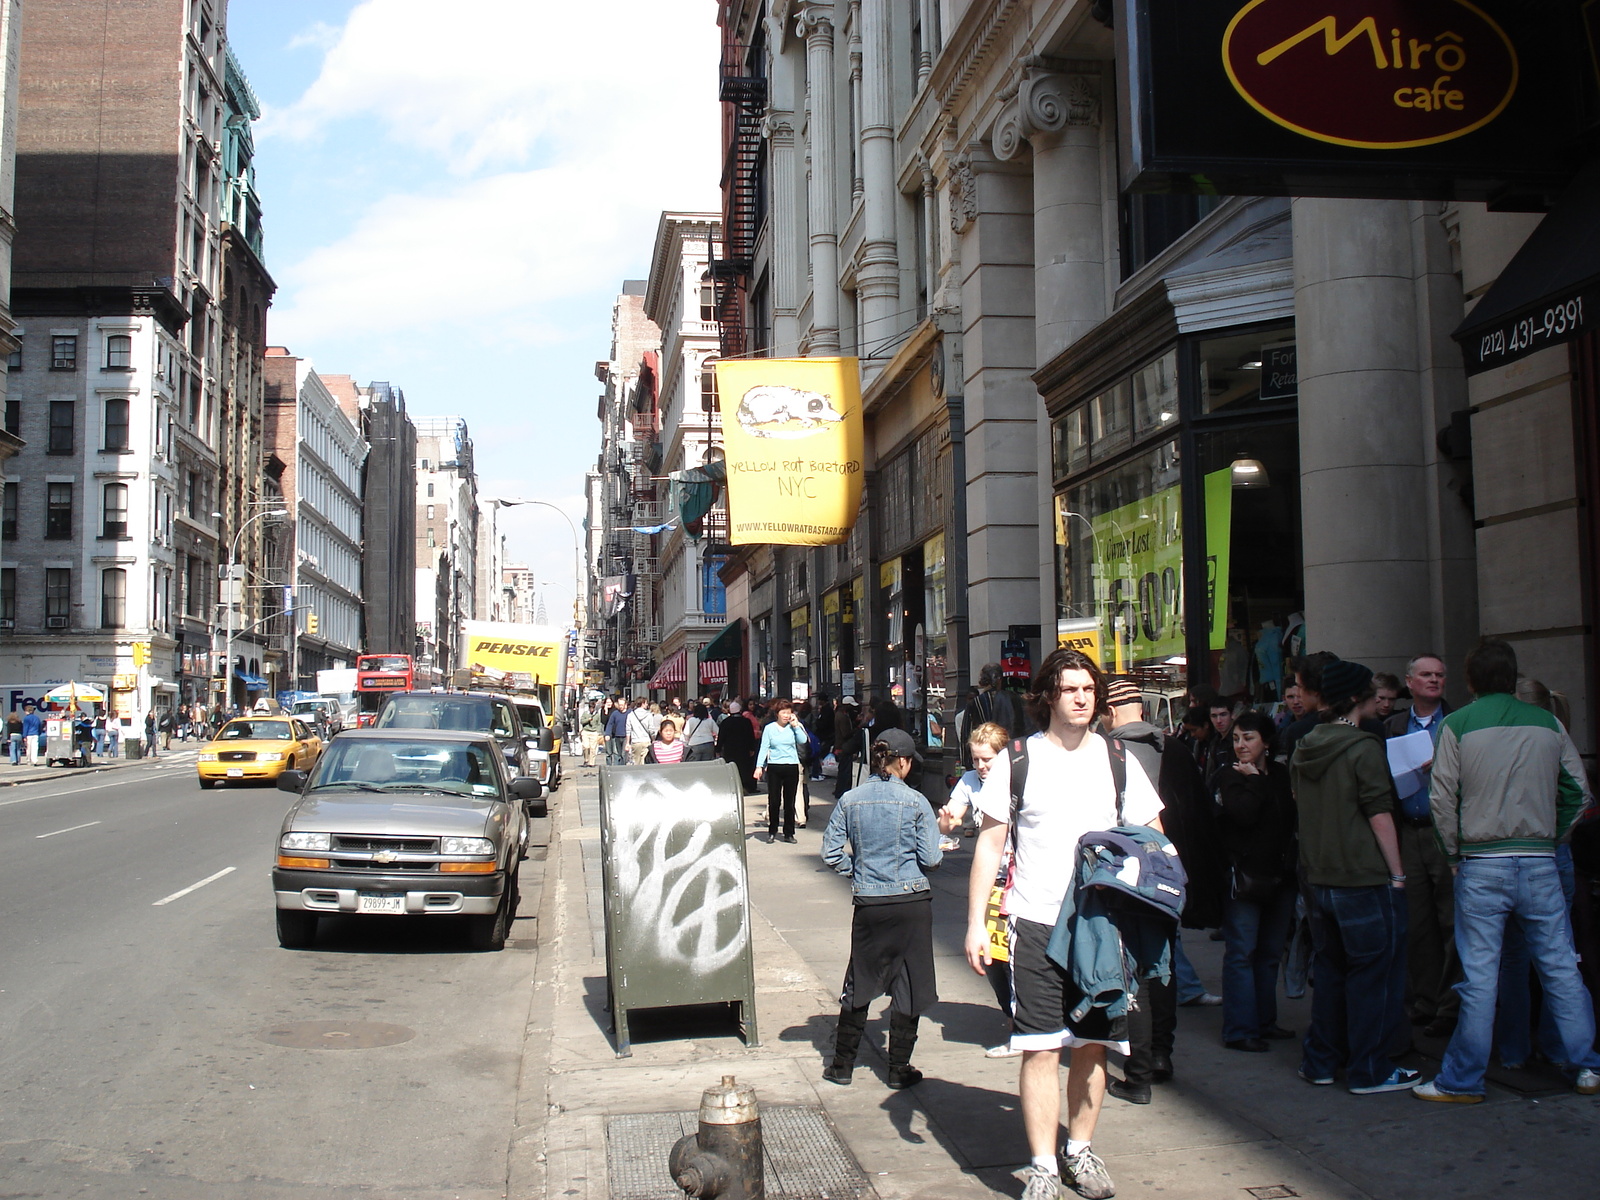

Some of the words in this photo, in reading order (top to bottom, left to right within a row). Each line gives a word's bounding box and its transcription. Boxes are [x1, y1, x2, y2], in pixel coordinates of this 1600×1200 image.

[1257, 15, 1466, 72] Mirô
[1393, 75, 1465, 112] cafe
[1481, 329, 1506, 362] (212)
[1509, 296, 1583, 351] 431-9391
[1271, 350, 1295, 366] For
[1270, 371, 1297, 389] Reta
[783, 456, 804, 473] Rat
[778, 476, 817, 499] NYC
[1106, 537, 1131, 562] Owner
[1132, 528, 1150, 555] Lost
[475, 641, 553, 658] PENSKE
